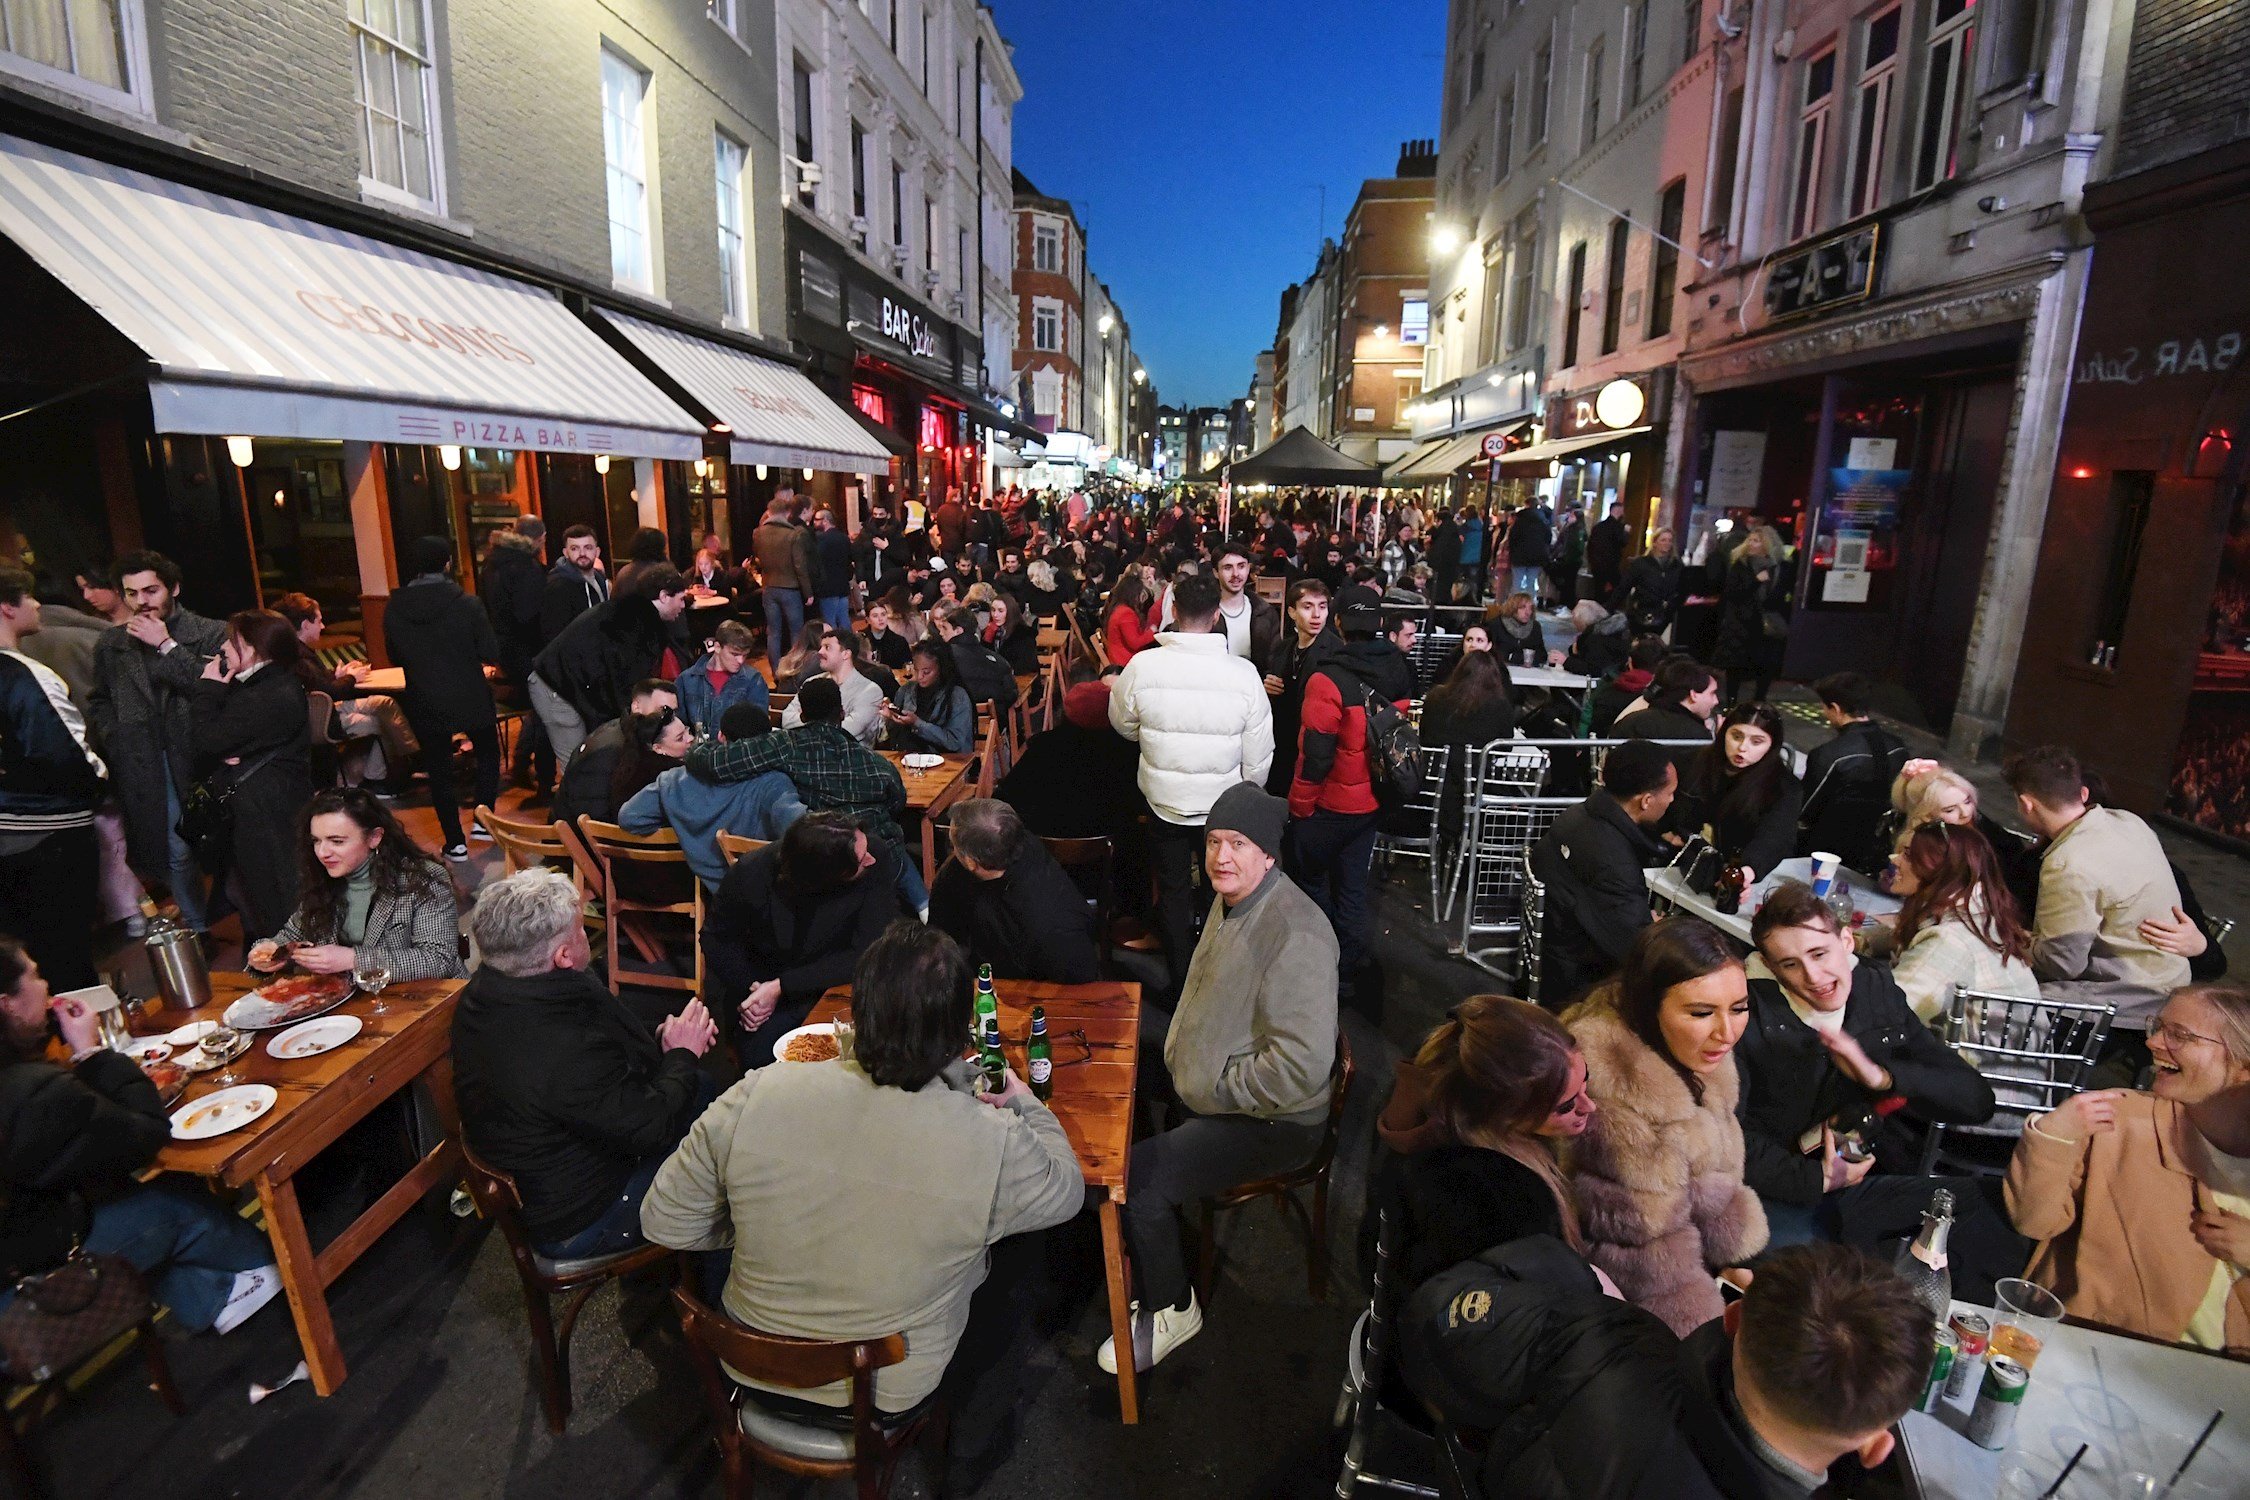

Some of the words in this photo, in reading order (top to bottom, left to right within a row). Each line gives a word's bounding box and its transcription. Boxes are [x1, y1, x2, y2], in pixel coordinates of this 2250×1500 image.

[883, 297, 910, 346] BAR
[911, 315, 935, 357] Soho
[453, 421, 526, 444] PIZZA
[538, 430, 578, 447] BAR
[1488, 440, 1504, 450] 20
